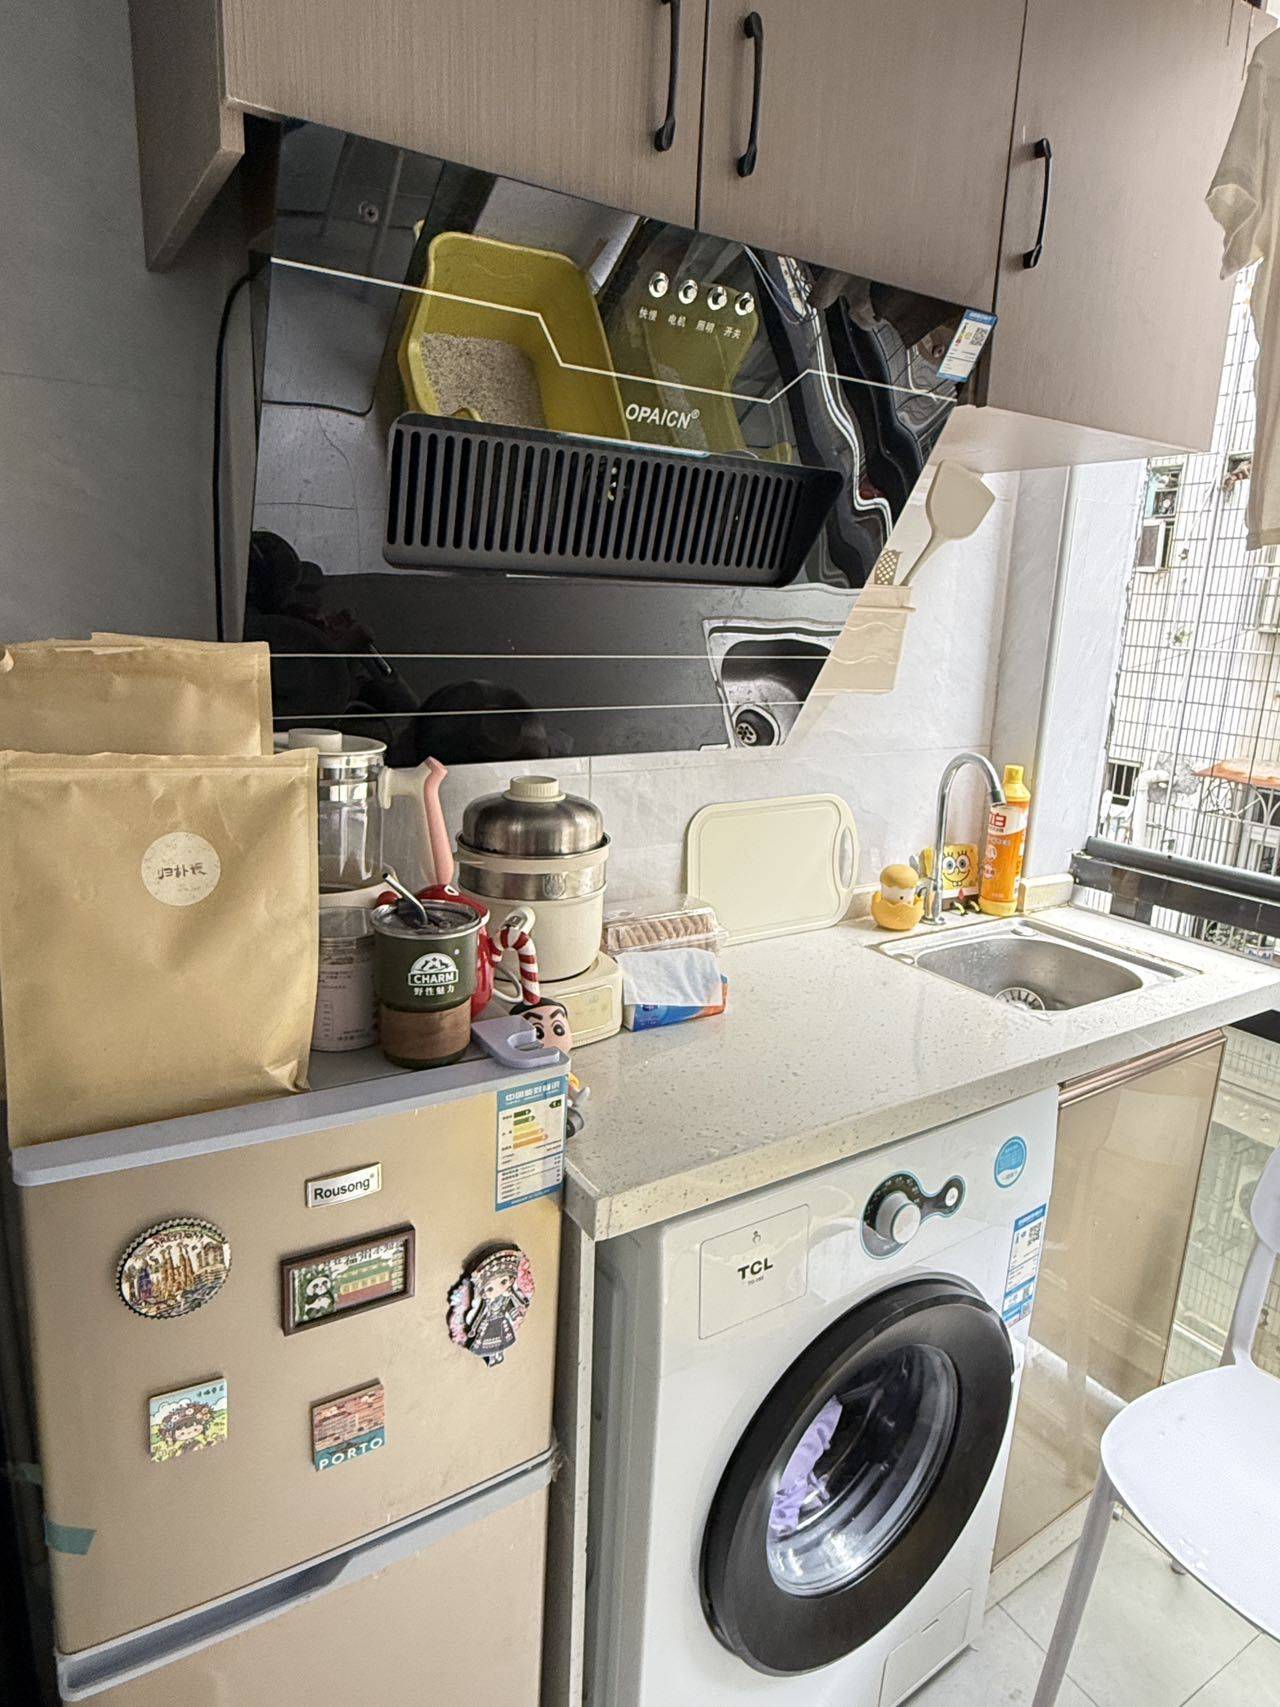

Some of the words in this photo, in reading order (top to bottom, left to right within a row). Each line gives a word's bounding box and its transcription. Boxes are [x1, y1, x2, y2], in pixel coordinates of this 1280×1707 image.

[668, 313, 687, 328] 电机
[723, 326, 741, 340] 开关
[413, 972, 455, 985] CHARM
[413, 984, 455, 997] 野性魅力
[314, 1178, 370, 1201] Rousong
[737, 1257, 774, 1281] TCL
[318, 1437, 384, 1471] PORTO
